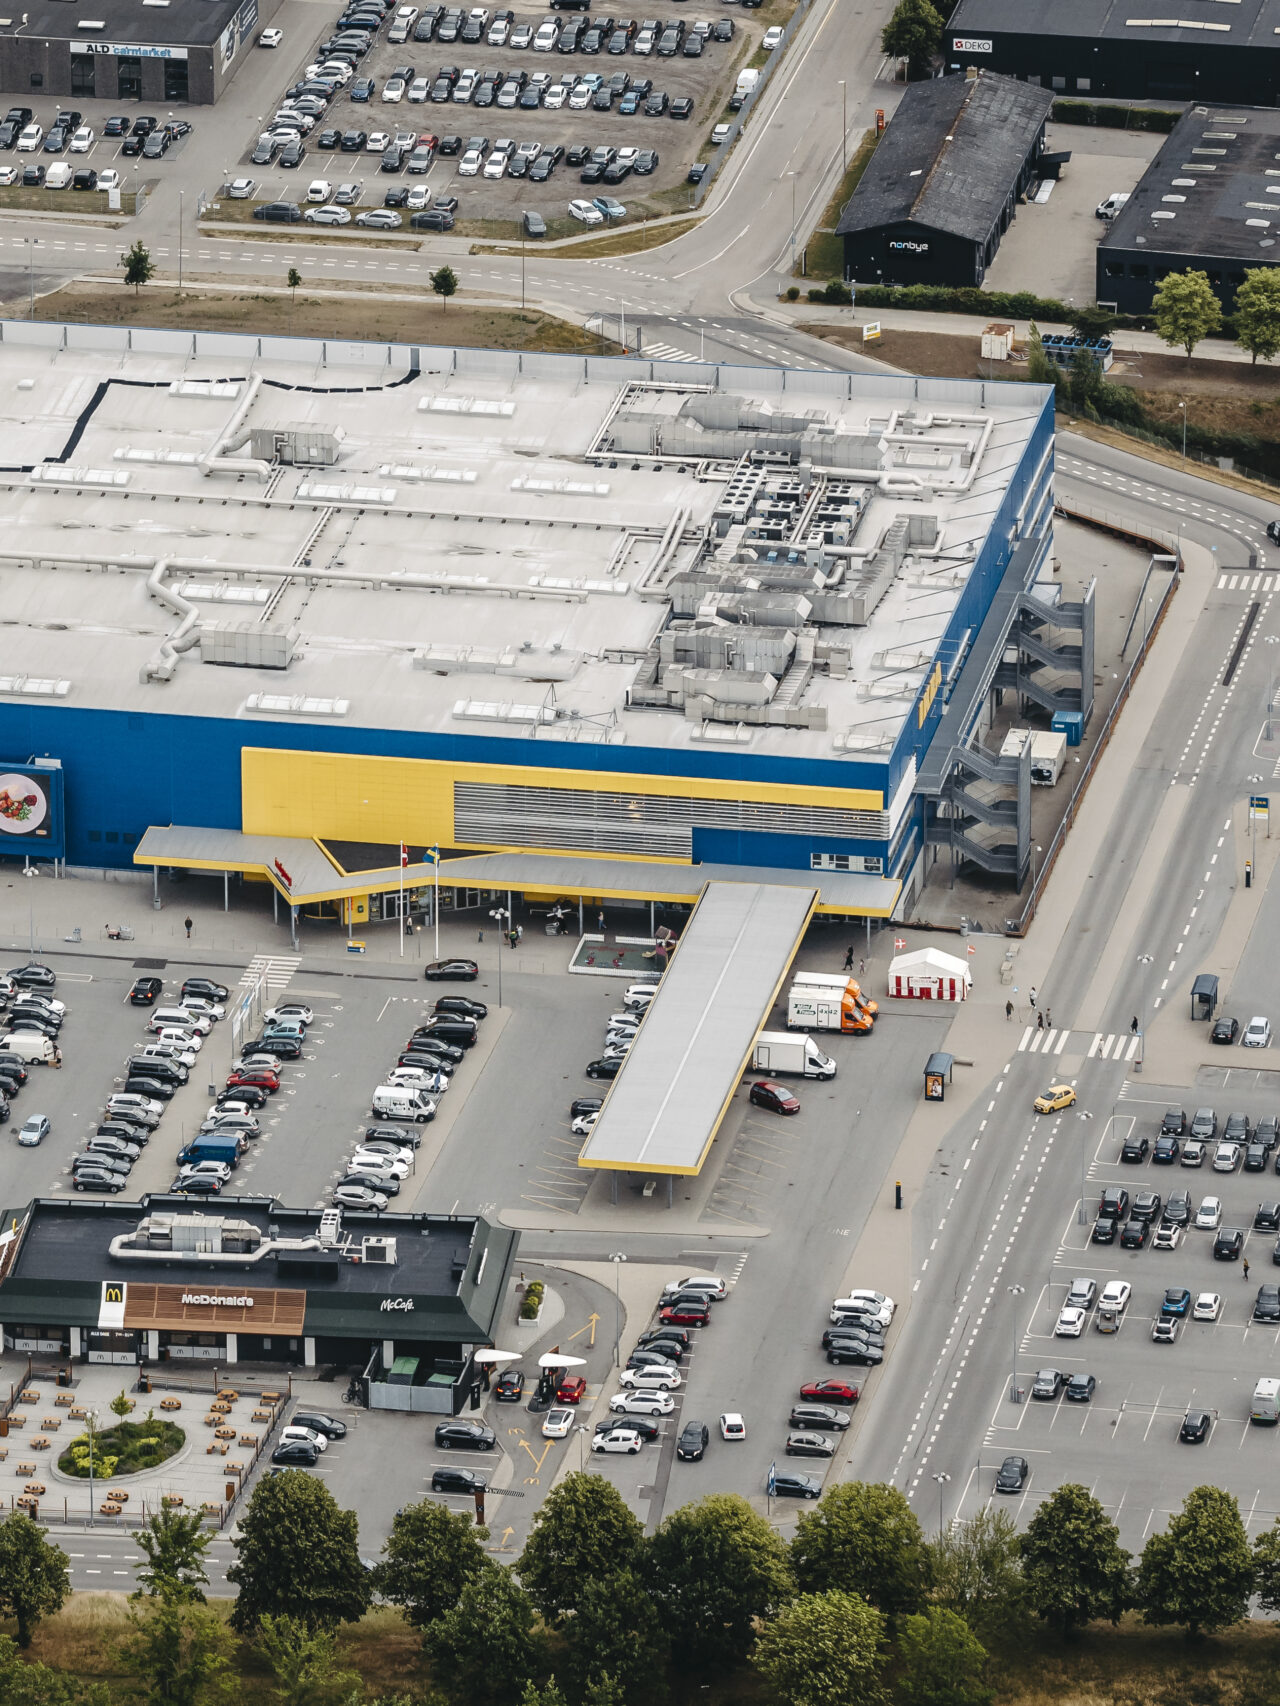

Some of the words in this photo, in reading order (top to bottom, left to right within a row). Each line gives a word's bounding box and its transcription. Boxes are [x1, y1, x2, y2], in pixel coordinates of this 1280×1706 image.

[86, 44, 110, 54] ALD
[113, 46, 172, 57] carmarket
[964, 41, 991, 51] DEKO
[889, 241, 929, 252] nonbye
[181, 1294, 253, 1306] McDonald's
